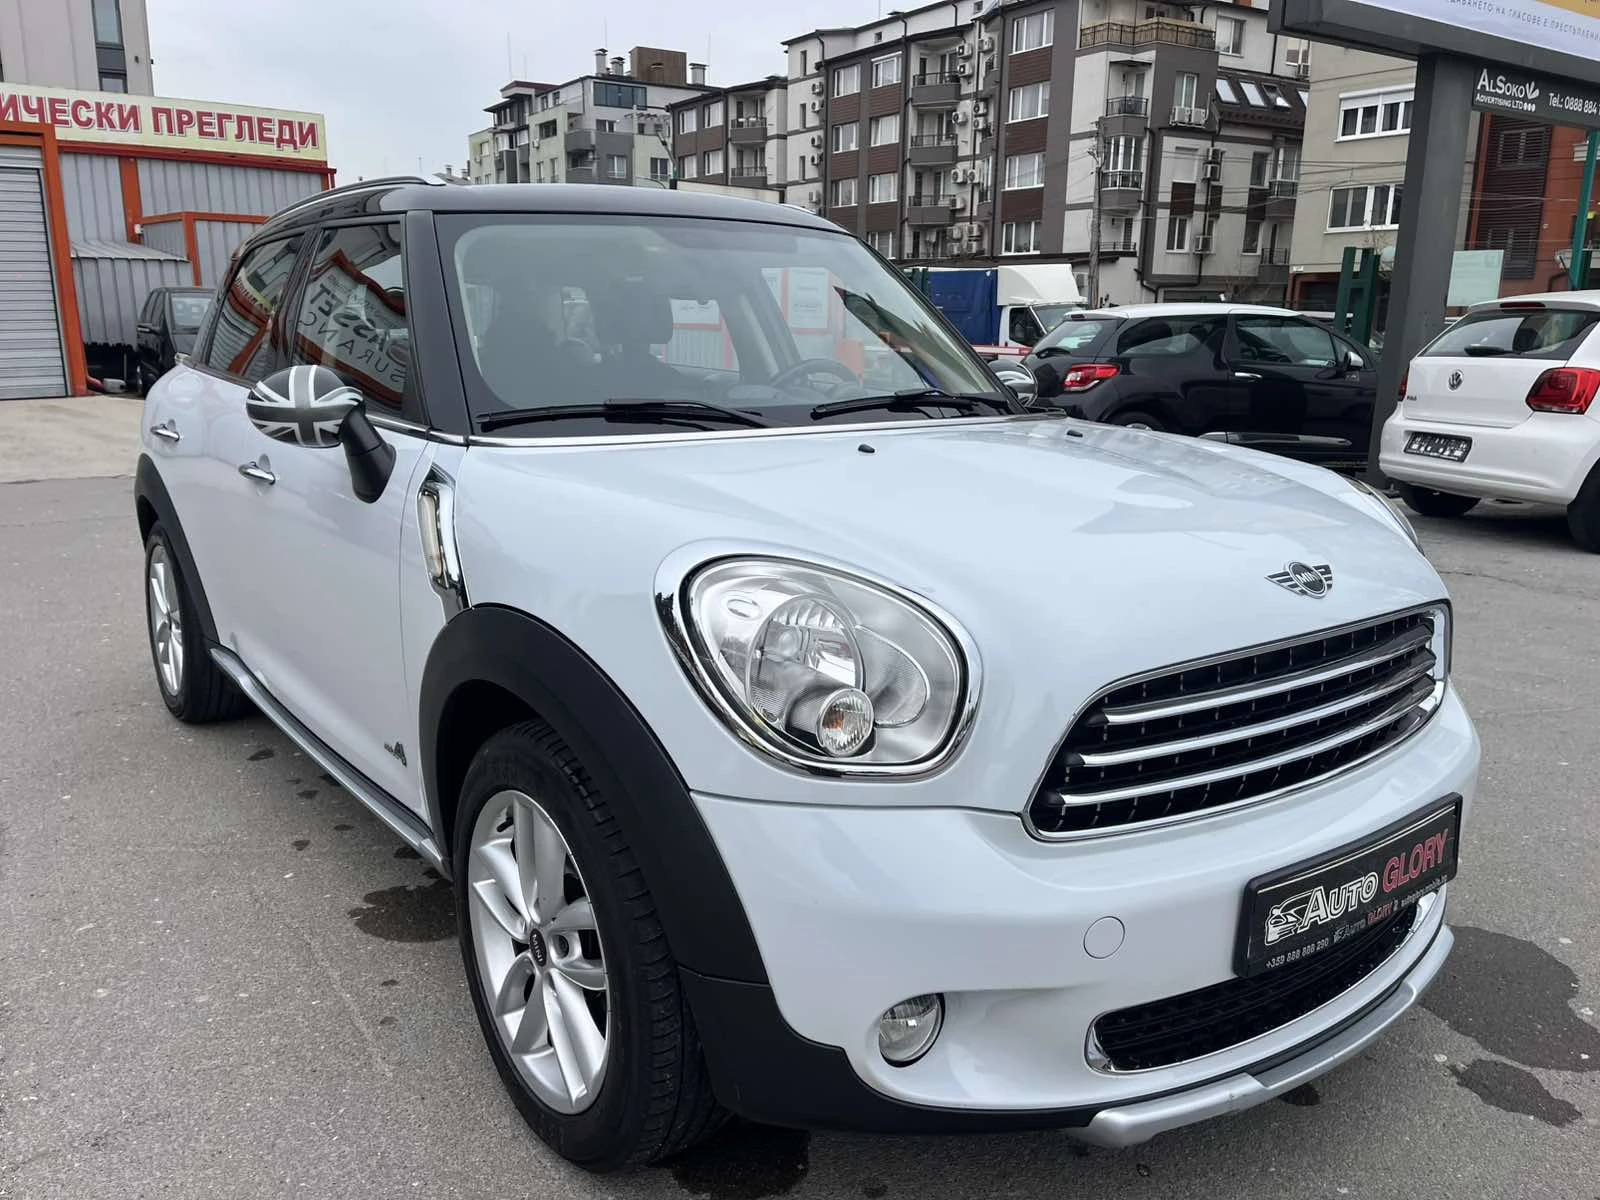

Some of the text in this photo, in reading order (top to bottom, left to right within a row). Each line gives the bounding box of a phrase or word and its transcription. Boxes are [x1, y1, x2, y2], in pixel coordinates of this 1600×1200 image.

[1550, 20, 1600, 41] ПРЕСТЪПЛЕНИ
[1564, 96, 1583, 112] 0888
[1584, 100, 1597, 115] 884
[151, 107, 319, 151] ПРЕГЛЕДИ
[1382, 828, 1449, 893] GLORY
